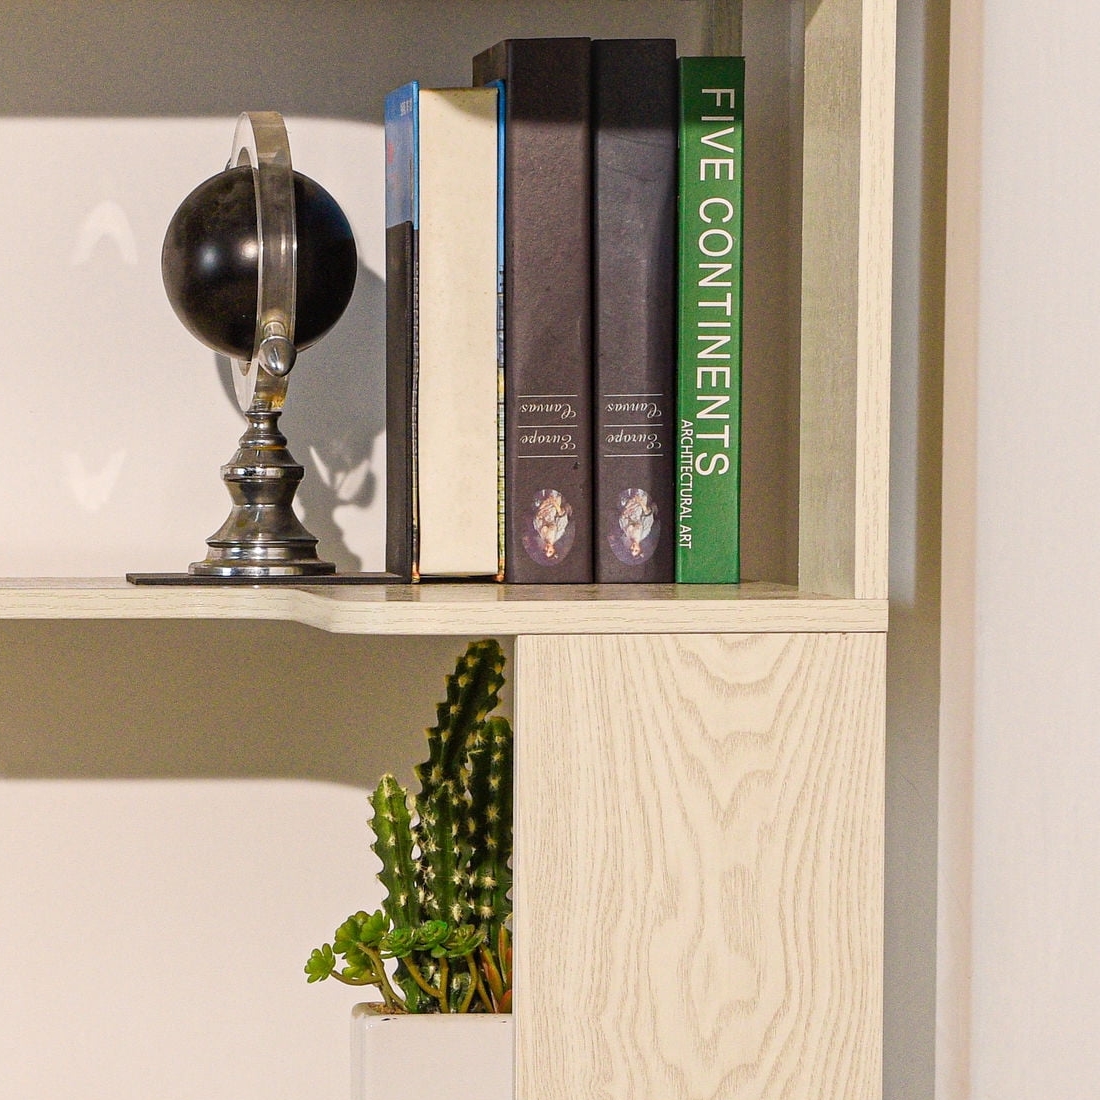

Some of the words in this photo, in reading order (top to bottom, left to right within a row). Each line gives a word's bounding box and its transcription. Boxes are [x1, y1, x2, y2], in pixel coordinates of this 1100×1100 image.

[700, 88, 735, 181] FIVE
[695, 197, 734, 476] CONTINENTS
[520, 402, 577, 419] Canvas
[606, 402, 662, 419] Canvas
[519, 429, 576, 450] Europe
[606, 428, 662, 450] Europe
[679, 419, 694, 521] ARCHITECTURAL
[679, 524, 692, 549] ART
